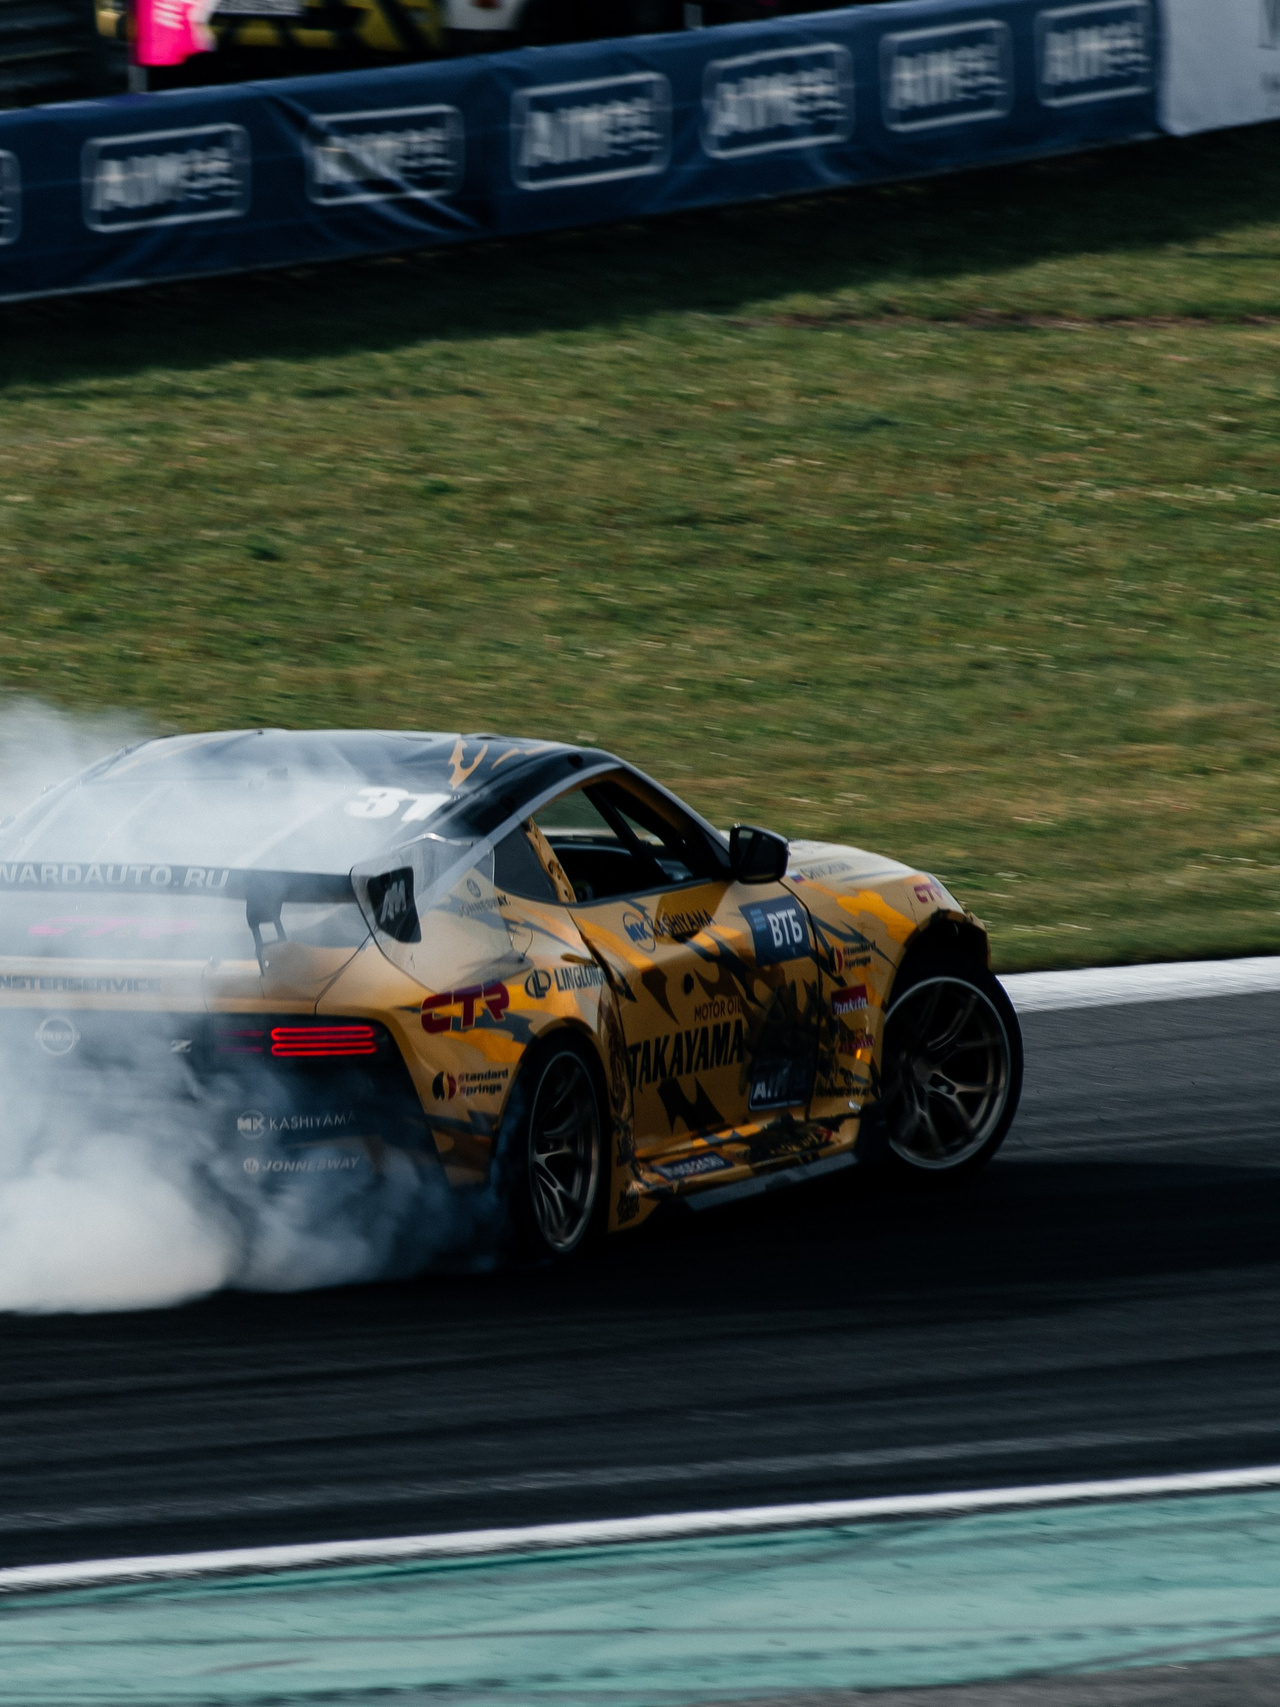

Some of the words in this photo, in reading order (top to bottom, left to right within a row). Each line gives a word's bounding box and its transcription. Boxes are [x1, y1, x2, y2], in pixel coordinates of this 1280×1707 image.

[648, 908, 716, 939] KASHIYAMA
[766, 907, 803, 948] ВТБ
[420, 981, 510, 1034] CTR
[694, 1002, 725, 1021] MOTOR
[727, 997, 742, 1015] OIL
[628, 1020, 744, 1088] TAKAYAMA
[458, 1068, 508, 1083] Standard
[458, 1084, 502, 1098] Springs
[262, 1156, 360, 1173] JONNESWAY
